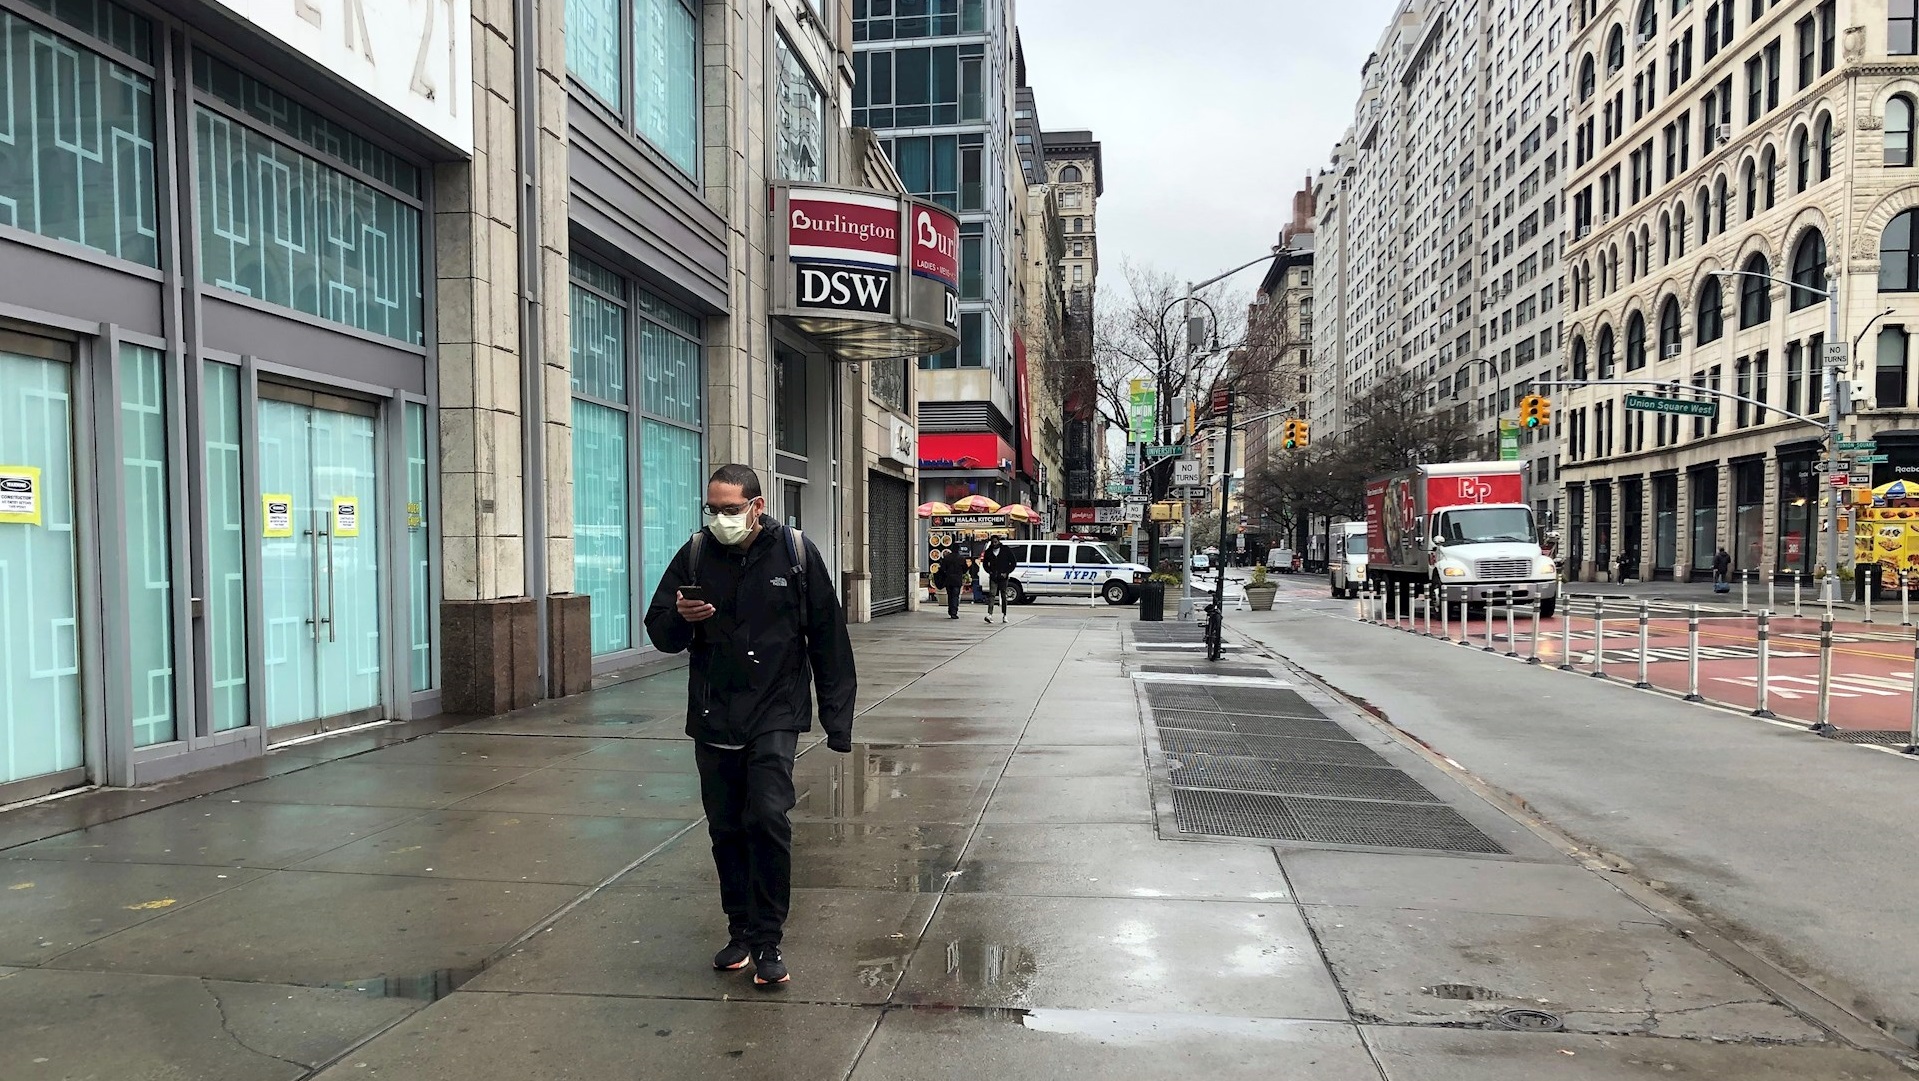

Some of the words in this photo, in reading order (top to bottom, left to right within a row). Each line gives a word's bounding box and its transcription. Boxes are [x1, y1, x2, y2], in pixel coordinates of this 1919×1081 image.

[791, 209, 895, 242] Burlington
[917, 260, 936, 271] LADIES
[801, 270, 888, 309] DSW
[1829, 346, 1841, 354] NO
[1823, 355, 1847, 363] TURNS
[1629, 398, 1655, 409] Union
[1657, 401, 1689, 412] Square
[1690, 404, 1713, 414] West
[1181, 464, 1193, 472] NO
[1176, 474, 1199, 482] TURNS
[1063, 570, 1098, 580] NYPD
